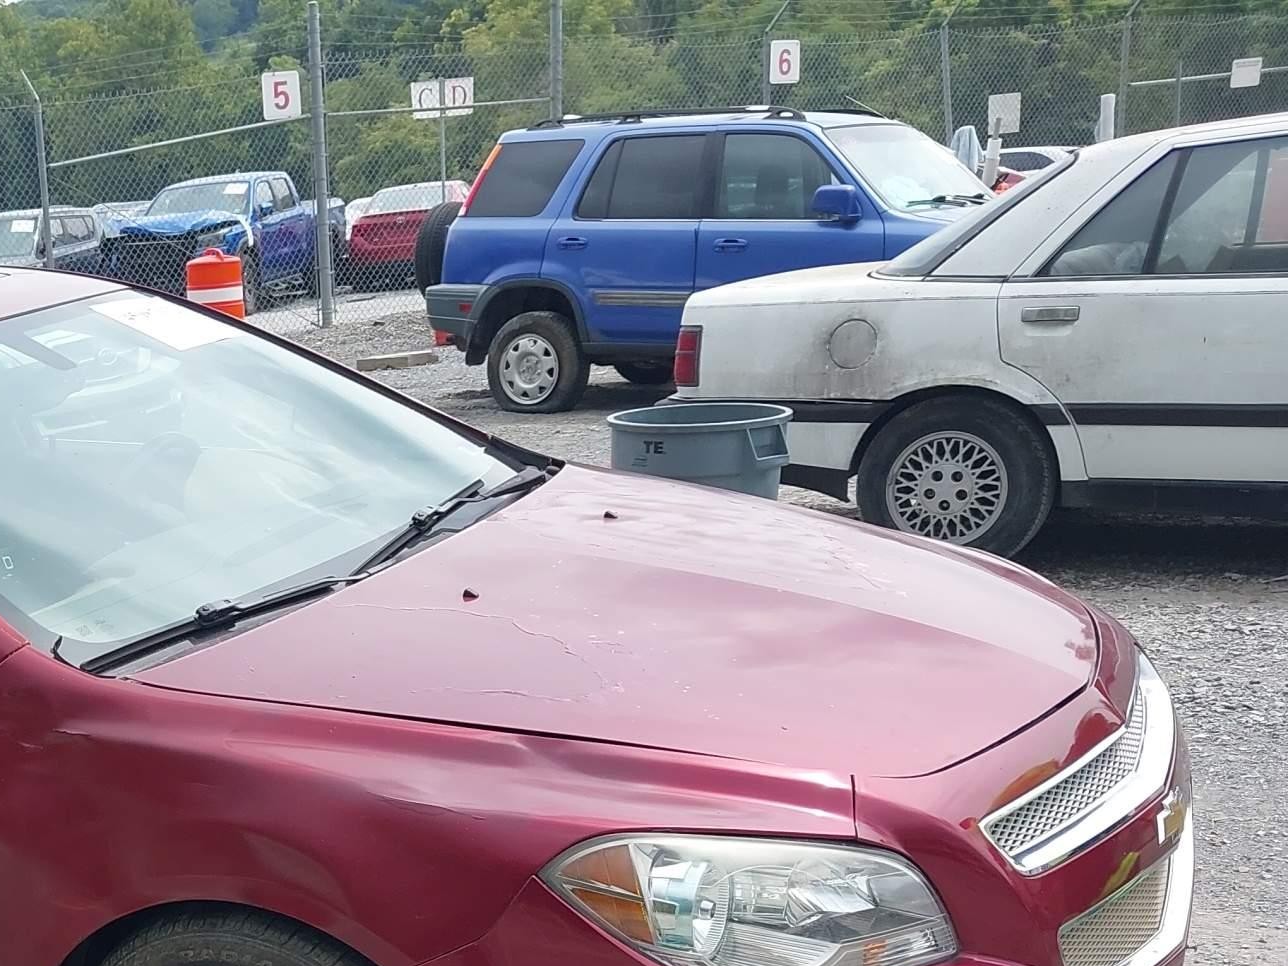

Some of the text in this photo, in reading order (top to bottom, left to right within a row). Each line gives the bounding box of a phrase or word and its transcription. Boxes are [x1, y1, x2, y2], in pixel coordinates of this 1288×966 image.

[778, 49, 792, 76] 6
[273, 80, 291, 109] 5
[642, 440, 665, 455] TE
